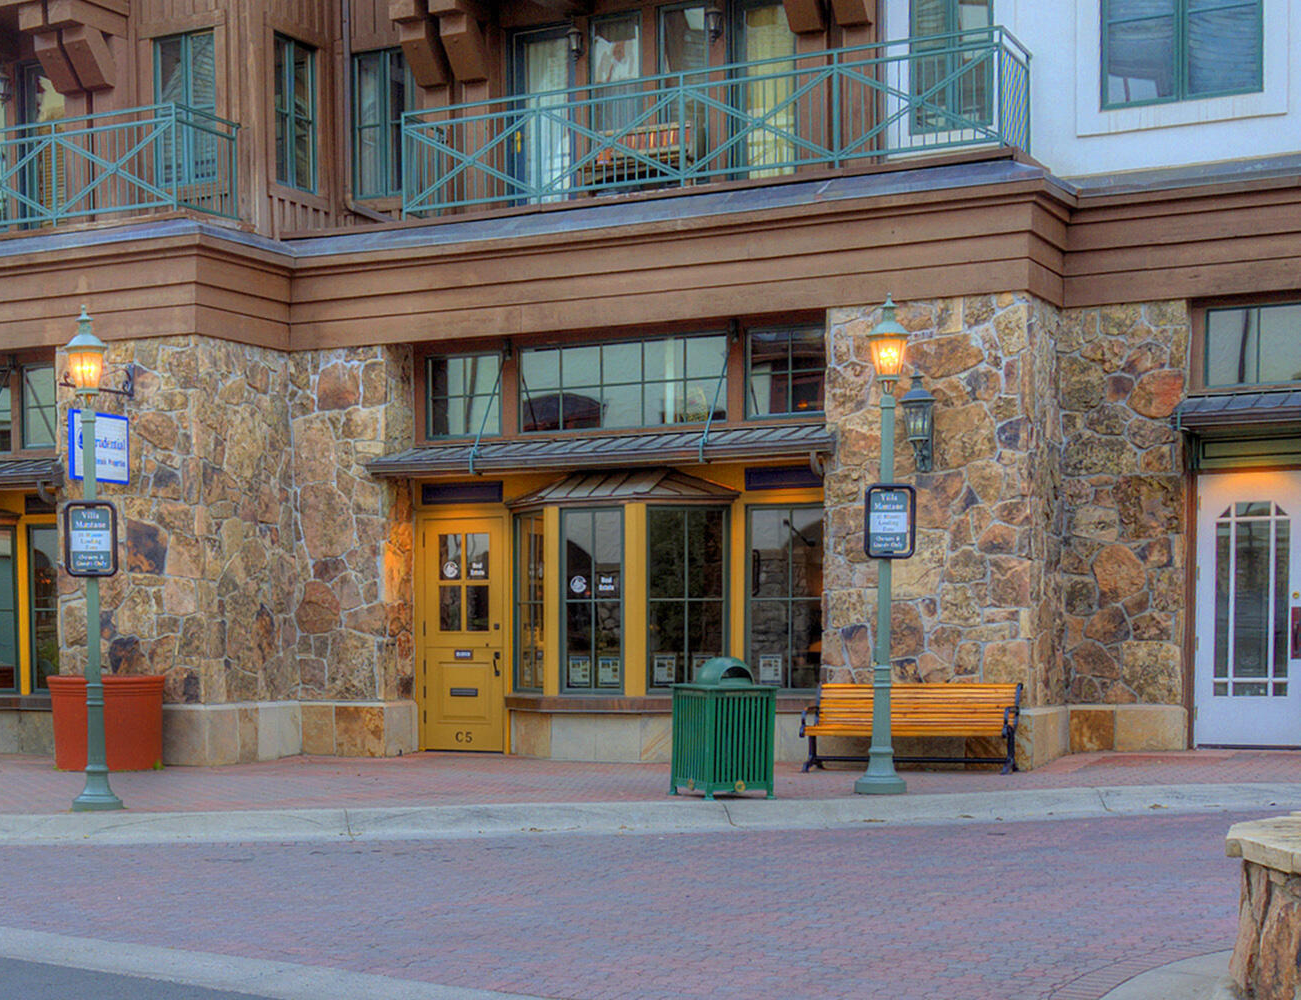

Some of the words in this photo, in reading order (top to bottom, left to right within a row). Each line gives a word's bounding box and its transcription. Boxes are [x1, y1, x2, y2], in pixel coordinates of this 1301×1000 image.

[880, 493, 898, 501] Villa
[81, 511, 99, 519] Villa
[455, 731, 473, 743] C5
